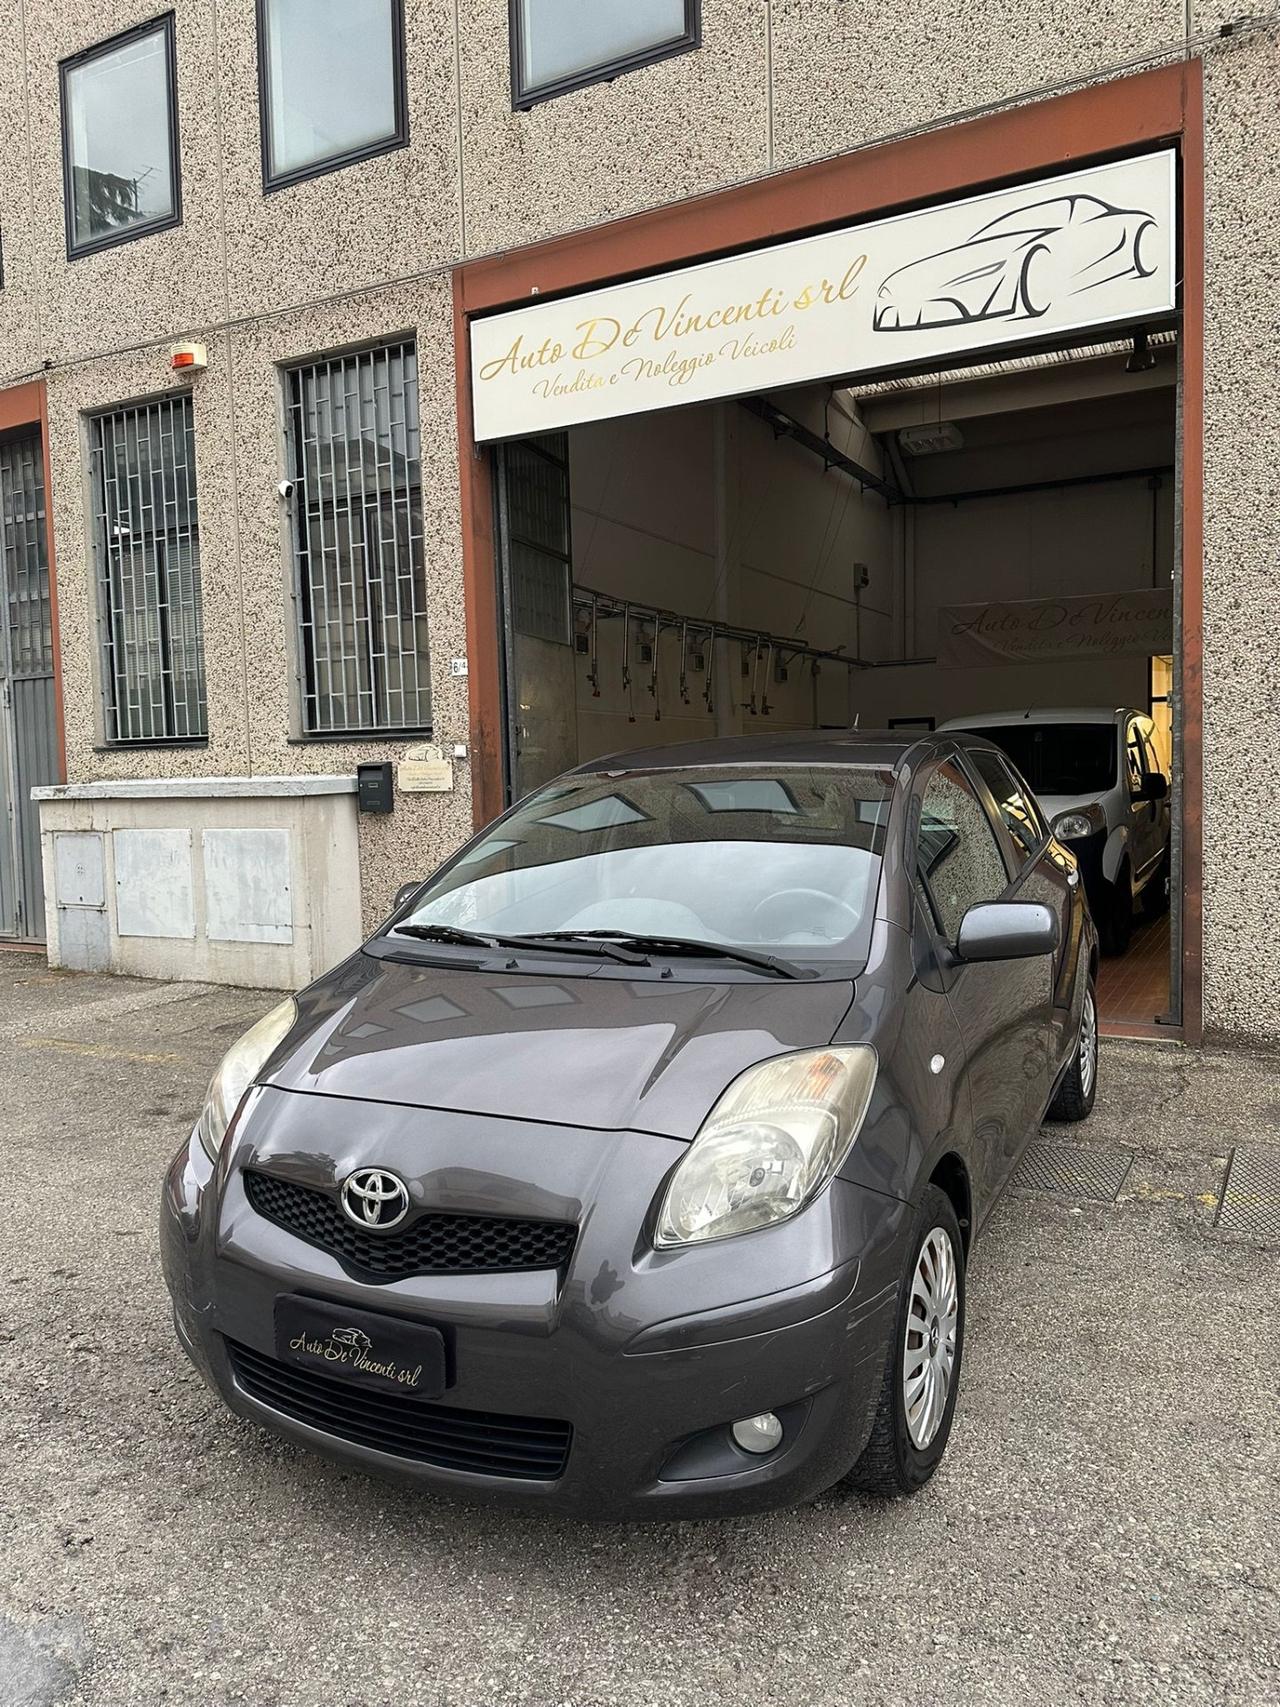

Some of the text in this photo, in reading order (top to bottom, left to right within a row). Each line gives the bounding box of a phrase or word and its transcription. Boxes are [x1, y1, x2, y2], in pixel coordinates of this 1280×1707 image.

[479, 254, 868, 381] Auto De Vincenti srl
[532, 325, 798, 399] Vendita e Noleggio Veicoli
[951, 607, 1020, 636] Auto
[290, 1331, 423, 1387] Auto De Vincenti srl
